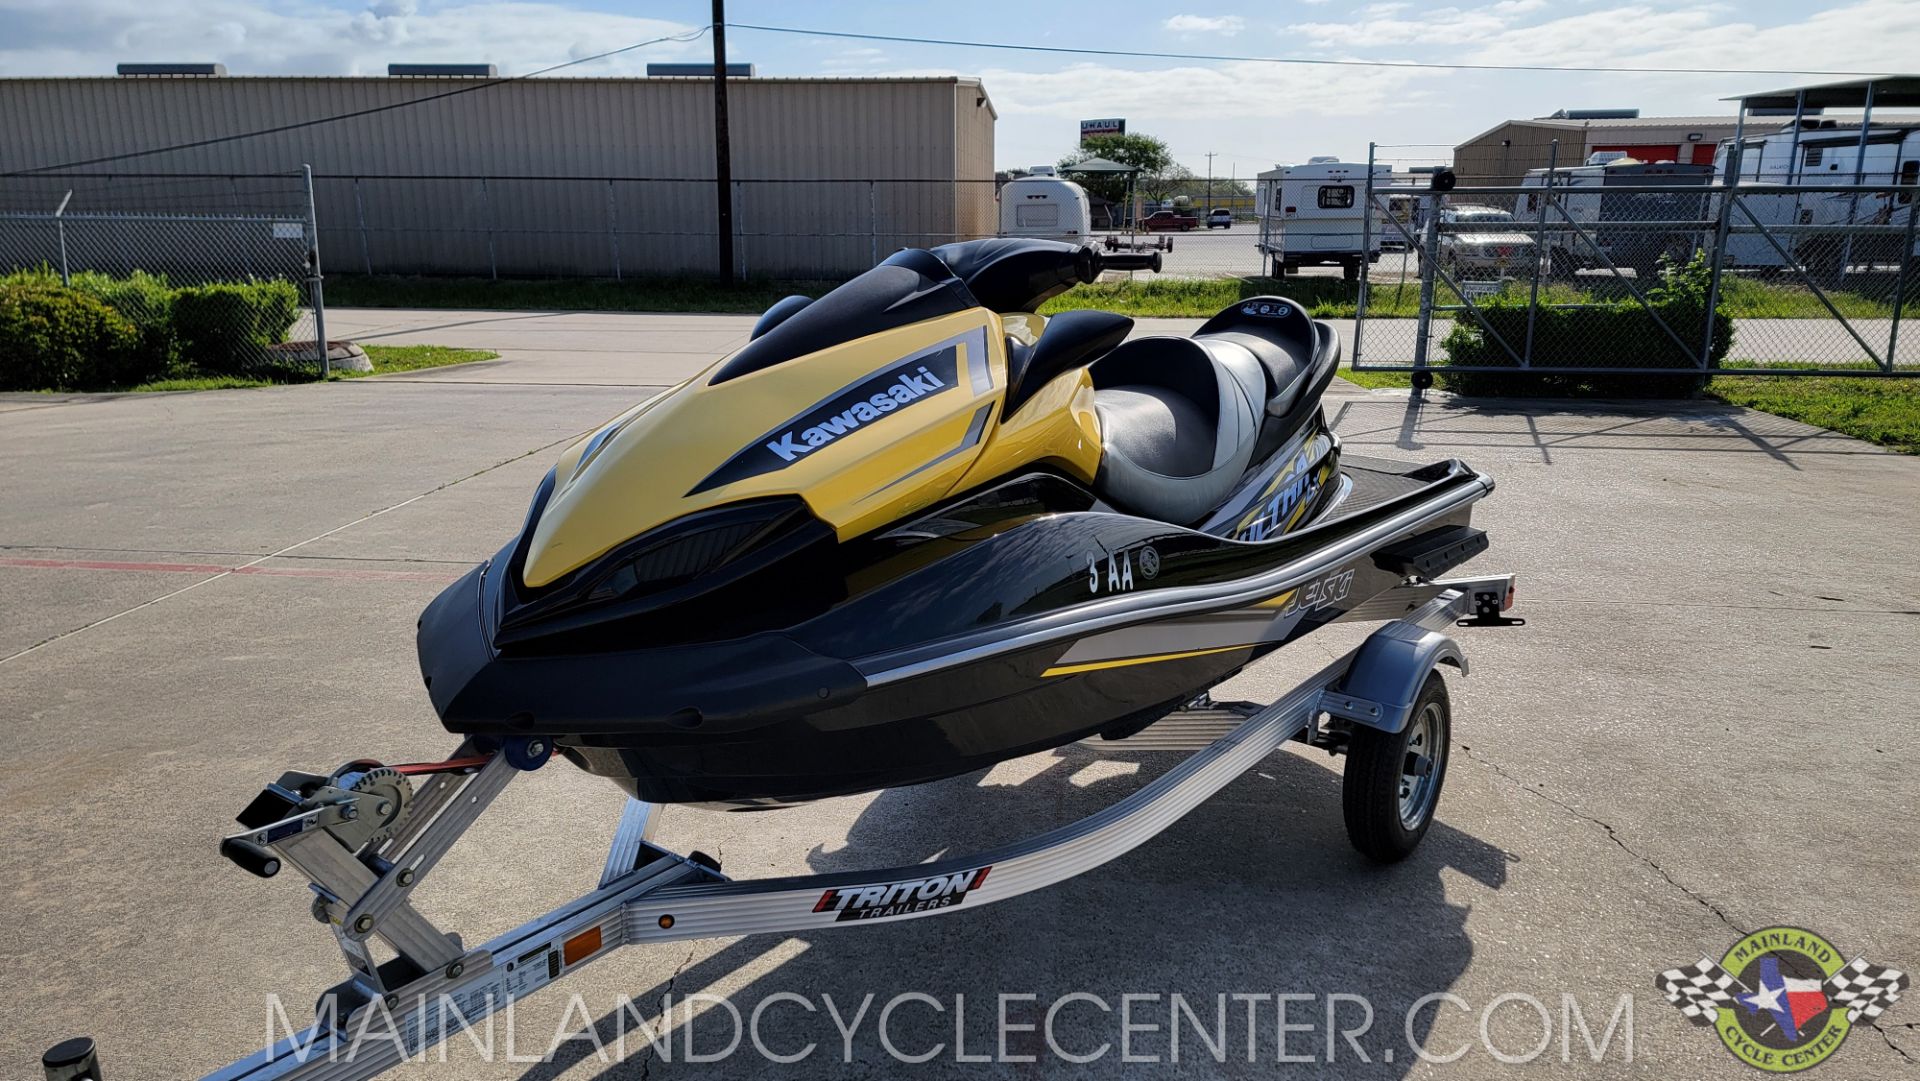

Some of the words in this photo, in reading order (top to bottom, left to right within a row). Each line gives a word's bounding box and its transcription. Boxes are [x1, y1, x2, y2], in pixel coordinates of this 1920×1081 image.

[766, 366, 946, 462] Kawasaki
[1086, 550, 1099, 594] 3
[1107, 548, 1134, 593] AA
[834, 869, 979, 912] TRITON
[859, 896, 951, 920] TRAILERS
